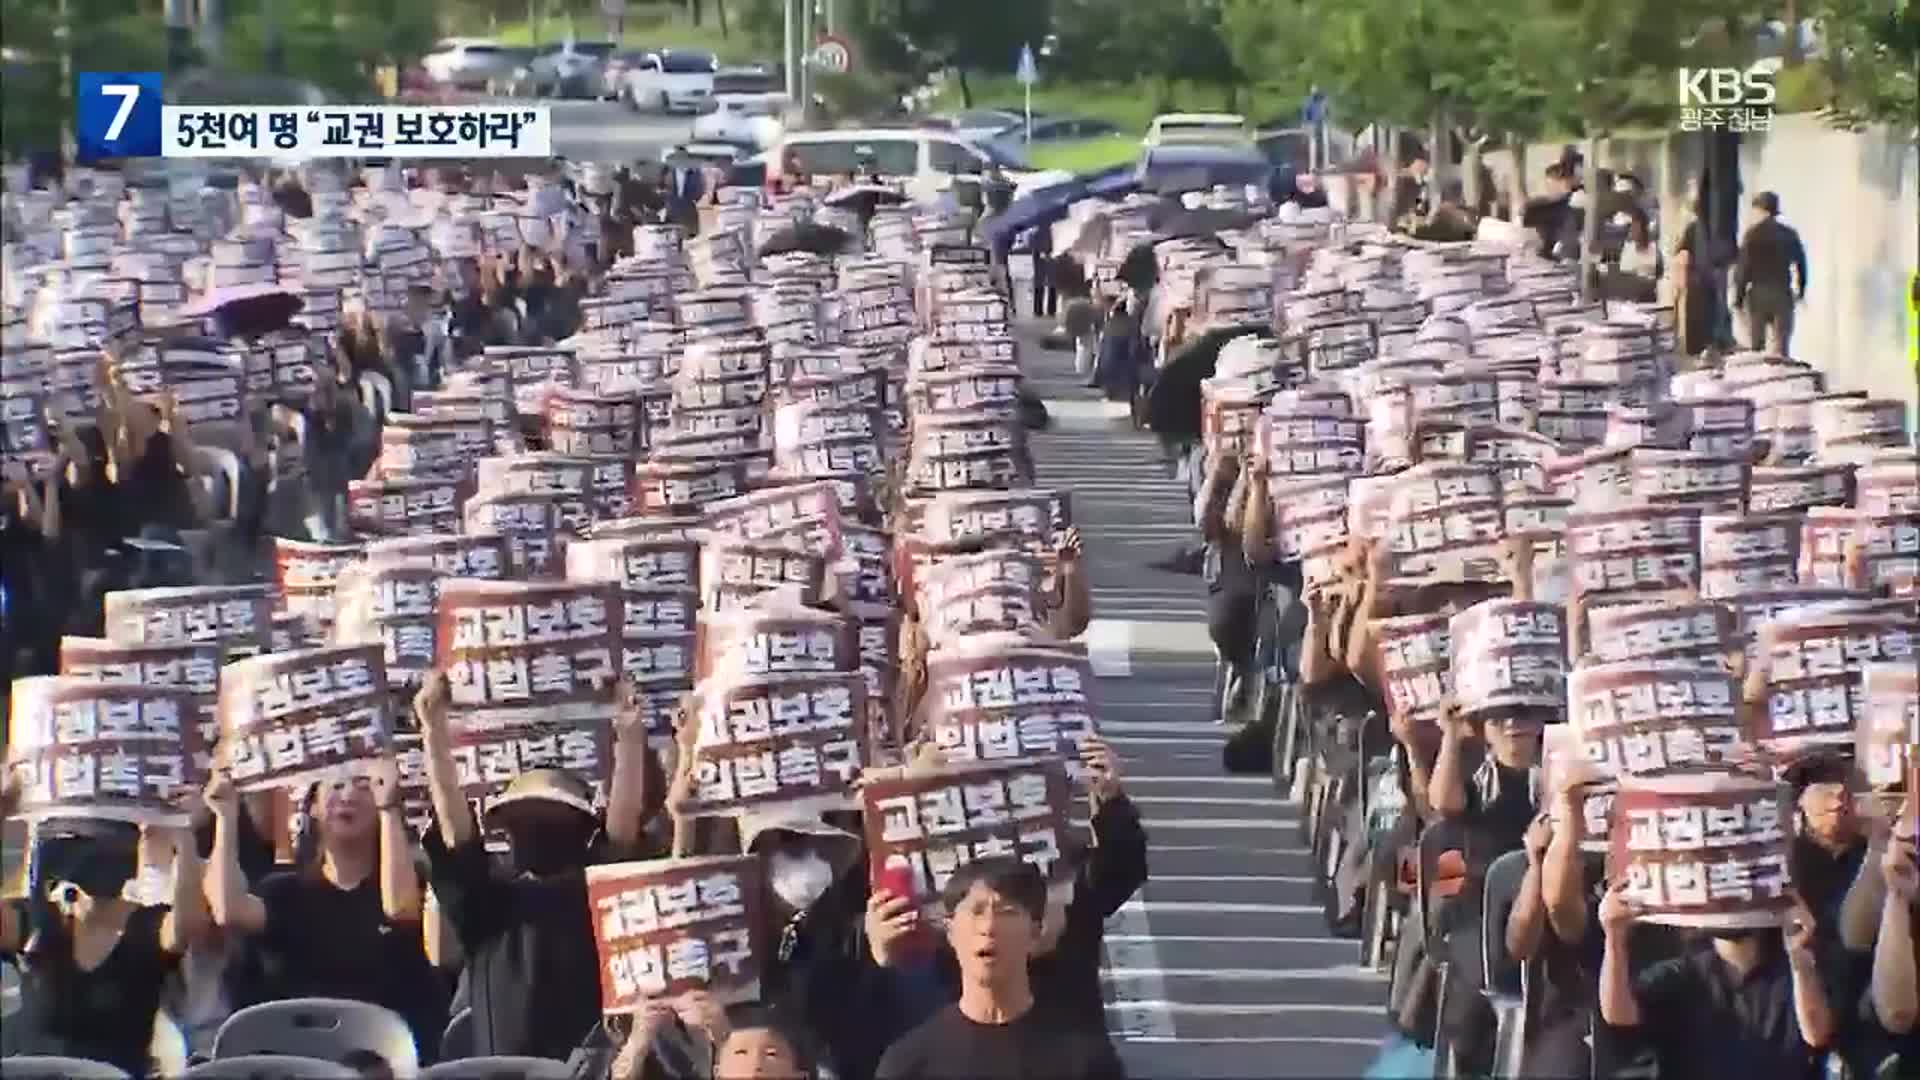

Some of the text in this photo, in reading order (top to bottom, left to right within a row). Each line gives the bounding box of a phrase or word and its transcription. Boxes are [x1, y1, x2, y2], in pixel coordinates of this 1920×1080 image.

[451, 595, 608, 650] 교권보호
[235, 658, 377, 722] 권보호
[449, 646, 618, 704] 입법촉구
[30, 698, 182, 746] 권보호
[697, 738, 861, 801] 입법촉구
[875, 772, 1052, 843] 교권보호
[1625, 799, 1785, 851] 교권보호
[1626, 852, 1792, 906] 입법촉구
[610, 922, 753, 999] 입법촉구
